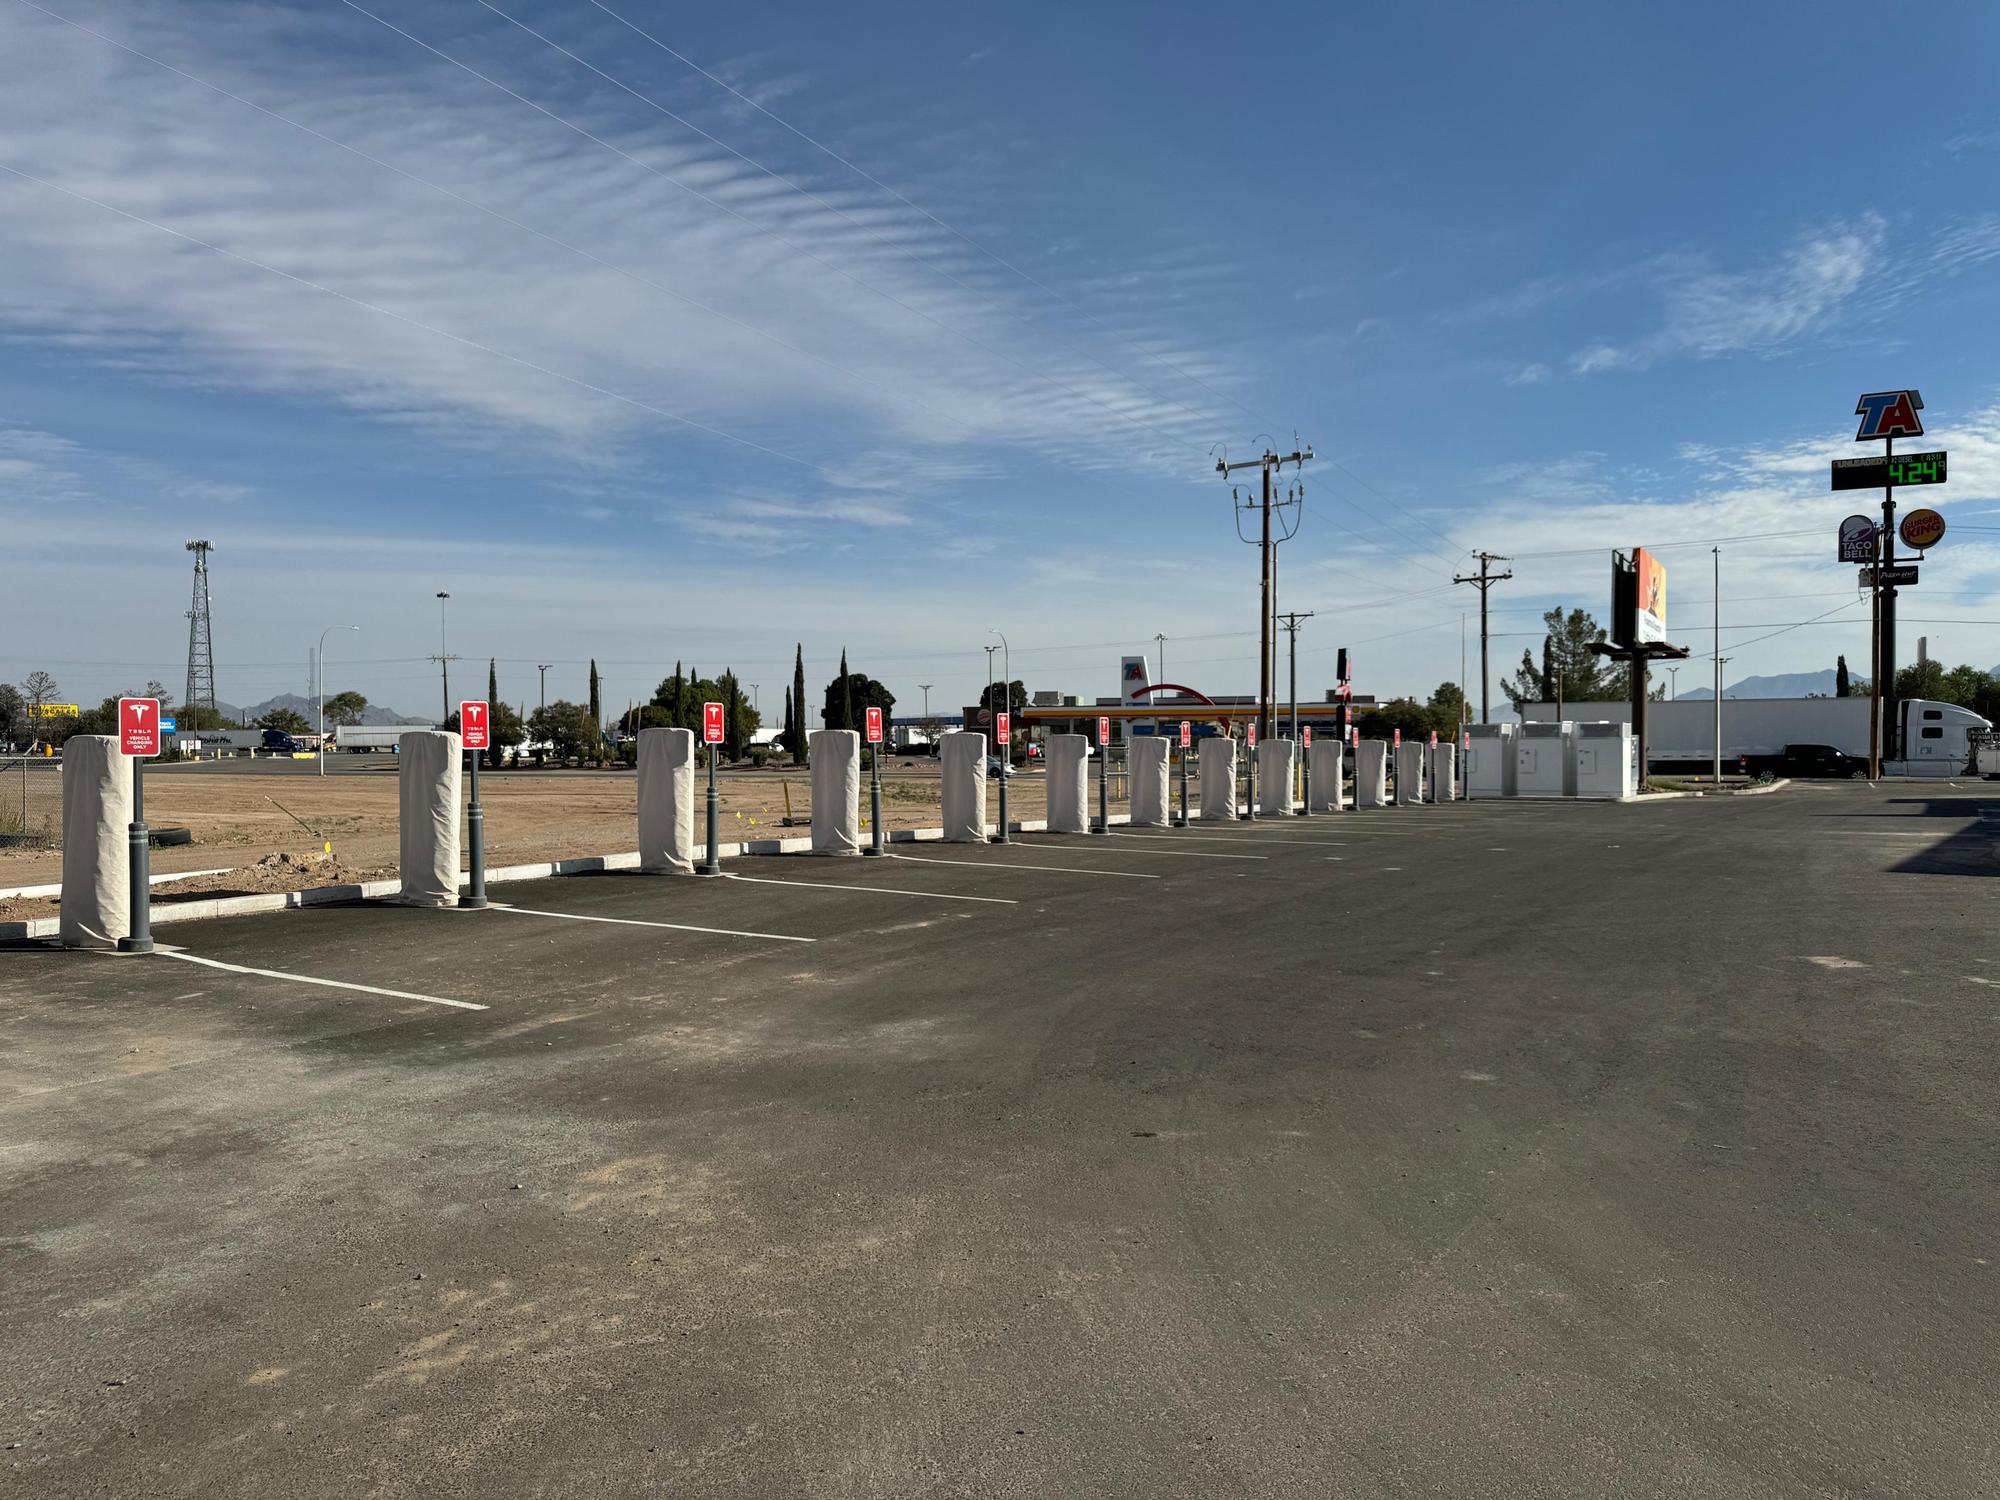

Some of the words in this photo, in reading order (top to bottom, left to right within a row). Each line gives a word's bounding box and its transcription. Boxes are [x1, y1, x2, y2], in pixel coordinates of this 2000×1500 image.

[1857, 391, 1922, 438] TA
[1905, 515, 1939, 530] BURGER
[1907, 522, 1940, 538] KING
[1842, 541, 1872, 550] TACO
[1844, 550, 1872, 559] BELL
[1124, 663, 1145, 680] TA
